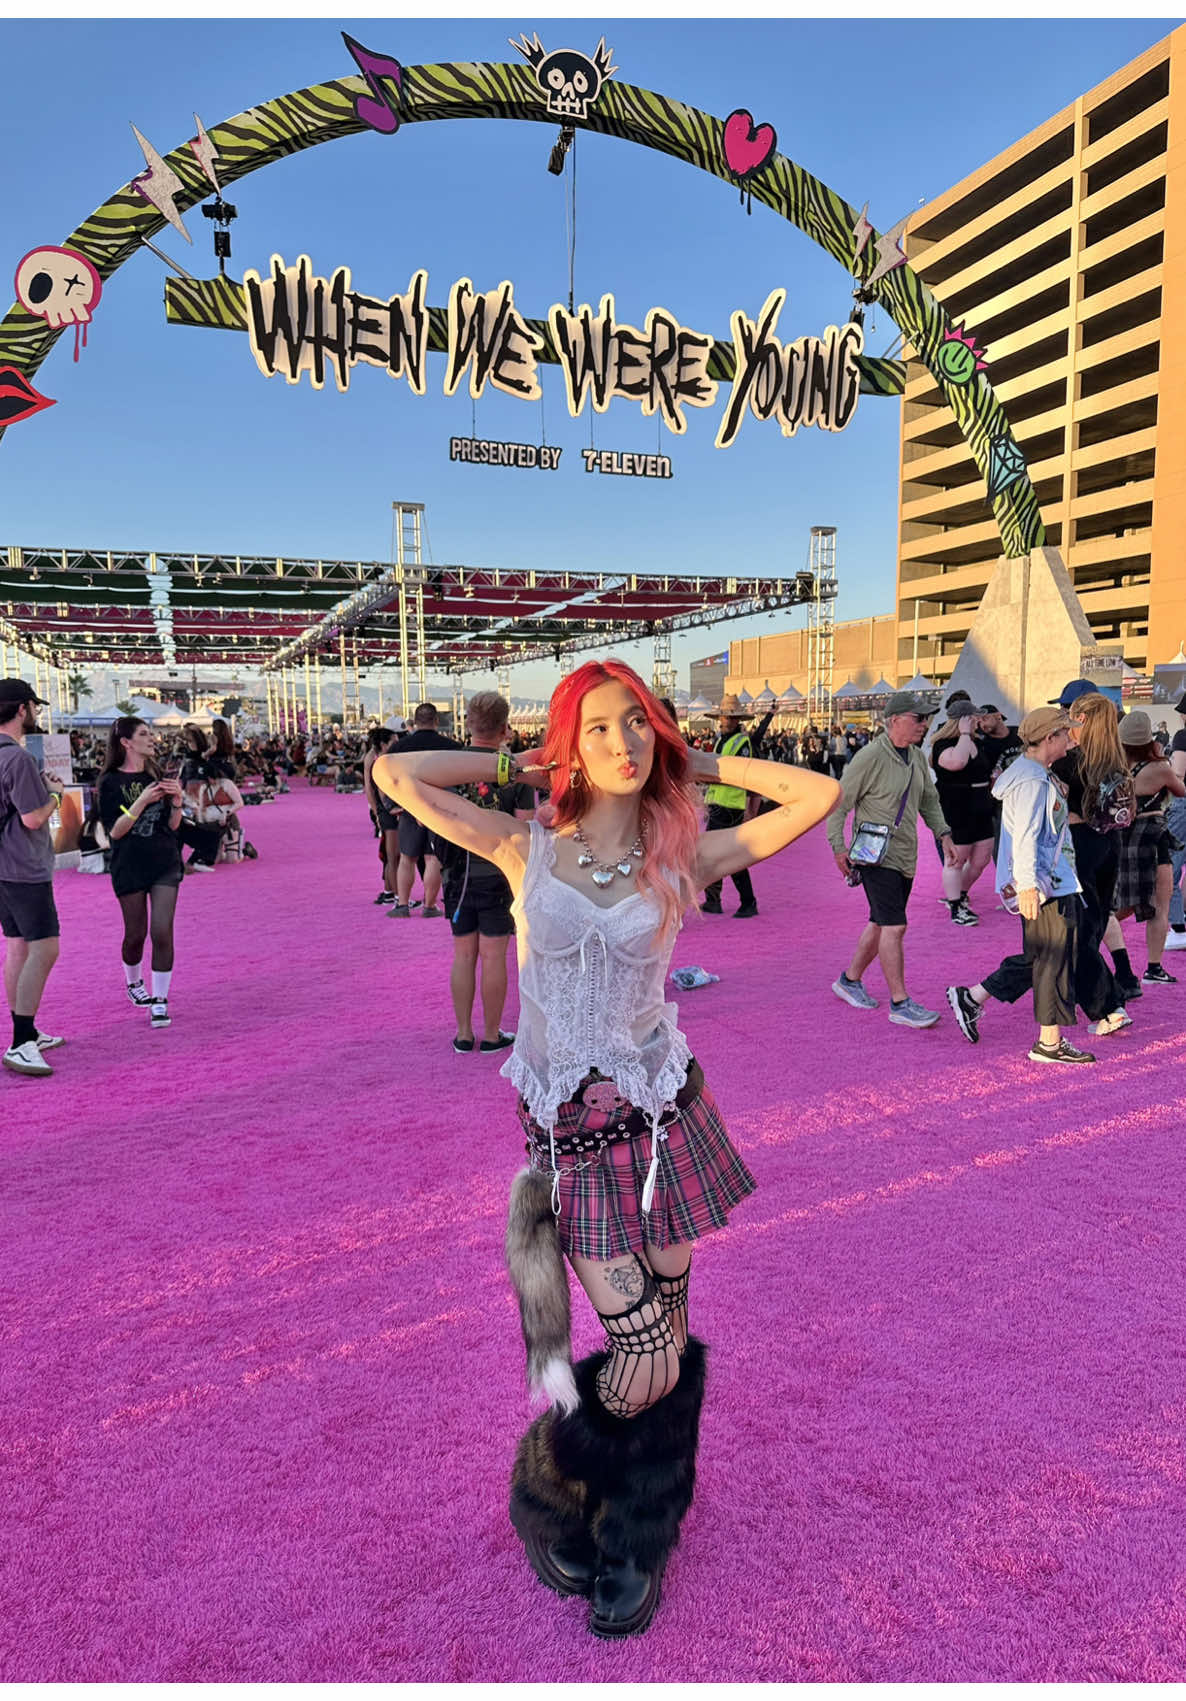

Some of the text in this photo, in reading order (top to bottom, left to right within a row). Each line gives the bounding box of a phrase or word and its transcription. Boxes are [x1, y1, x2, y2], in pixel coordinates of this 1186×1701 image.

[247, 258, 863, 445] WHEN WE WERE YOUNG
[451, 438, 562, 469] PRESENTED BY
